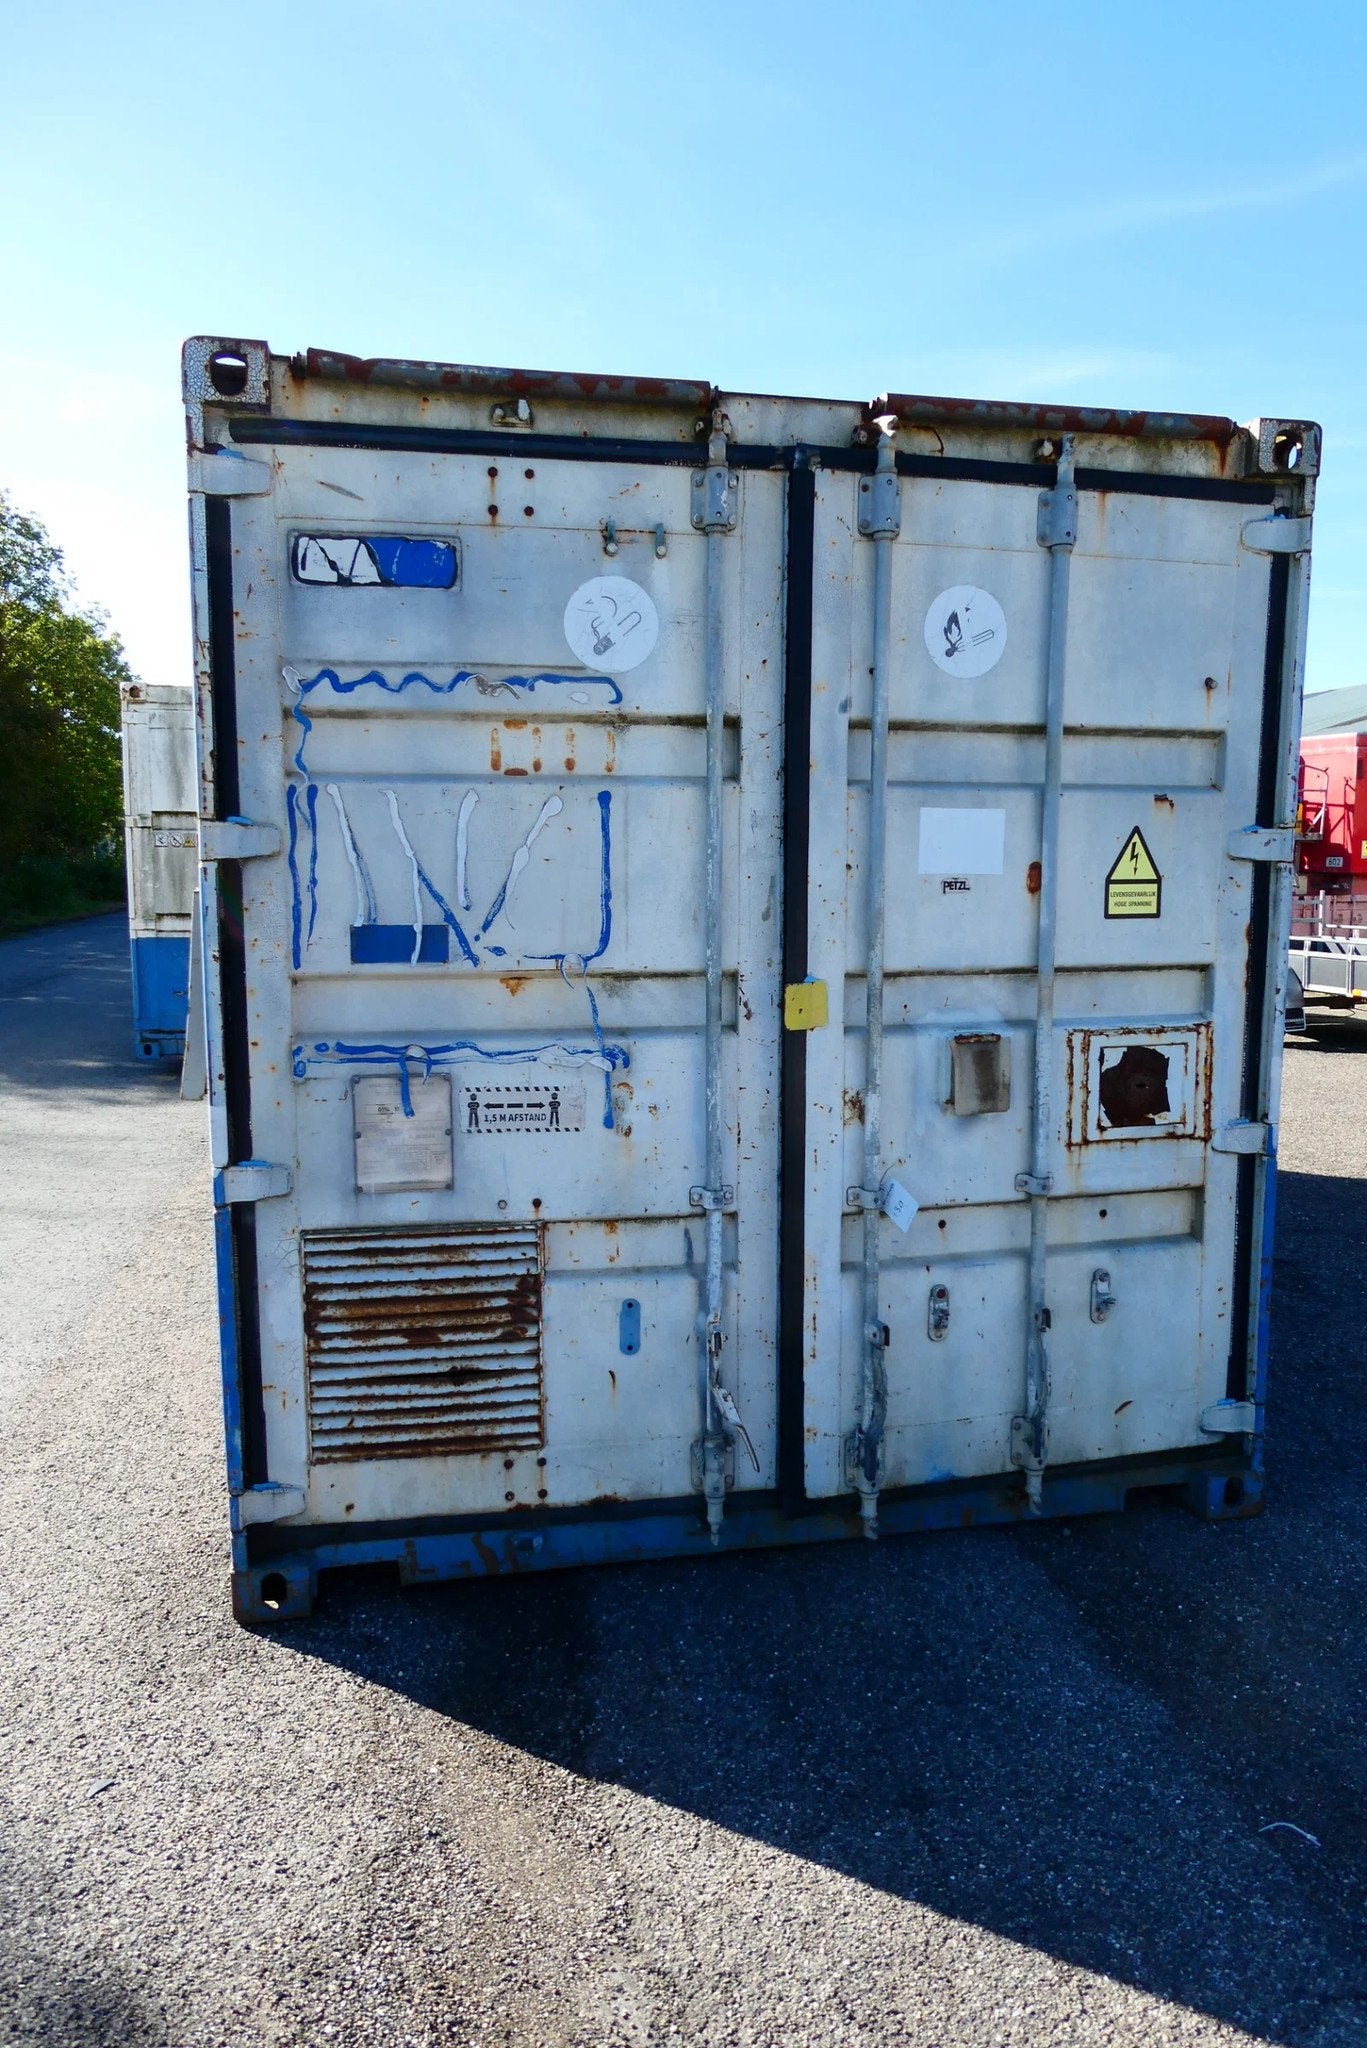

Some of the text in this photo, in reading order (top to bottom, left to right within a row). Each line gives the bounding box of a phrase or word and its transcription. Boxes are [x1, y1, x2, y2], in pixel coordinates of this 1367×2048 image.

[942, 881, 971, 895] PETZL
[484, 1113, 547, 1124] 1,5 M AFSTAND
